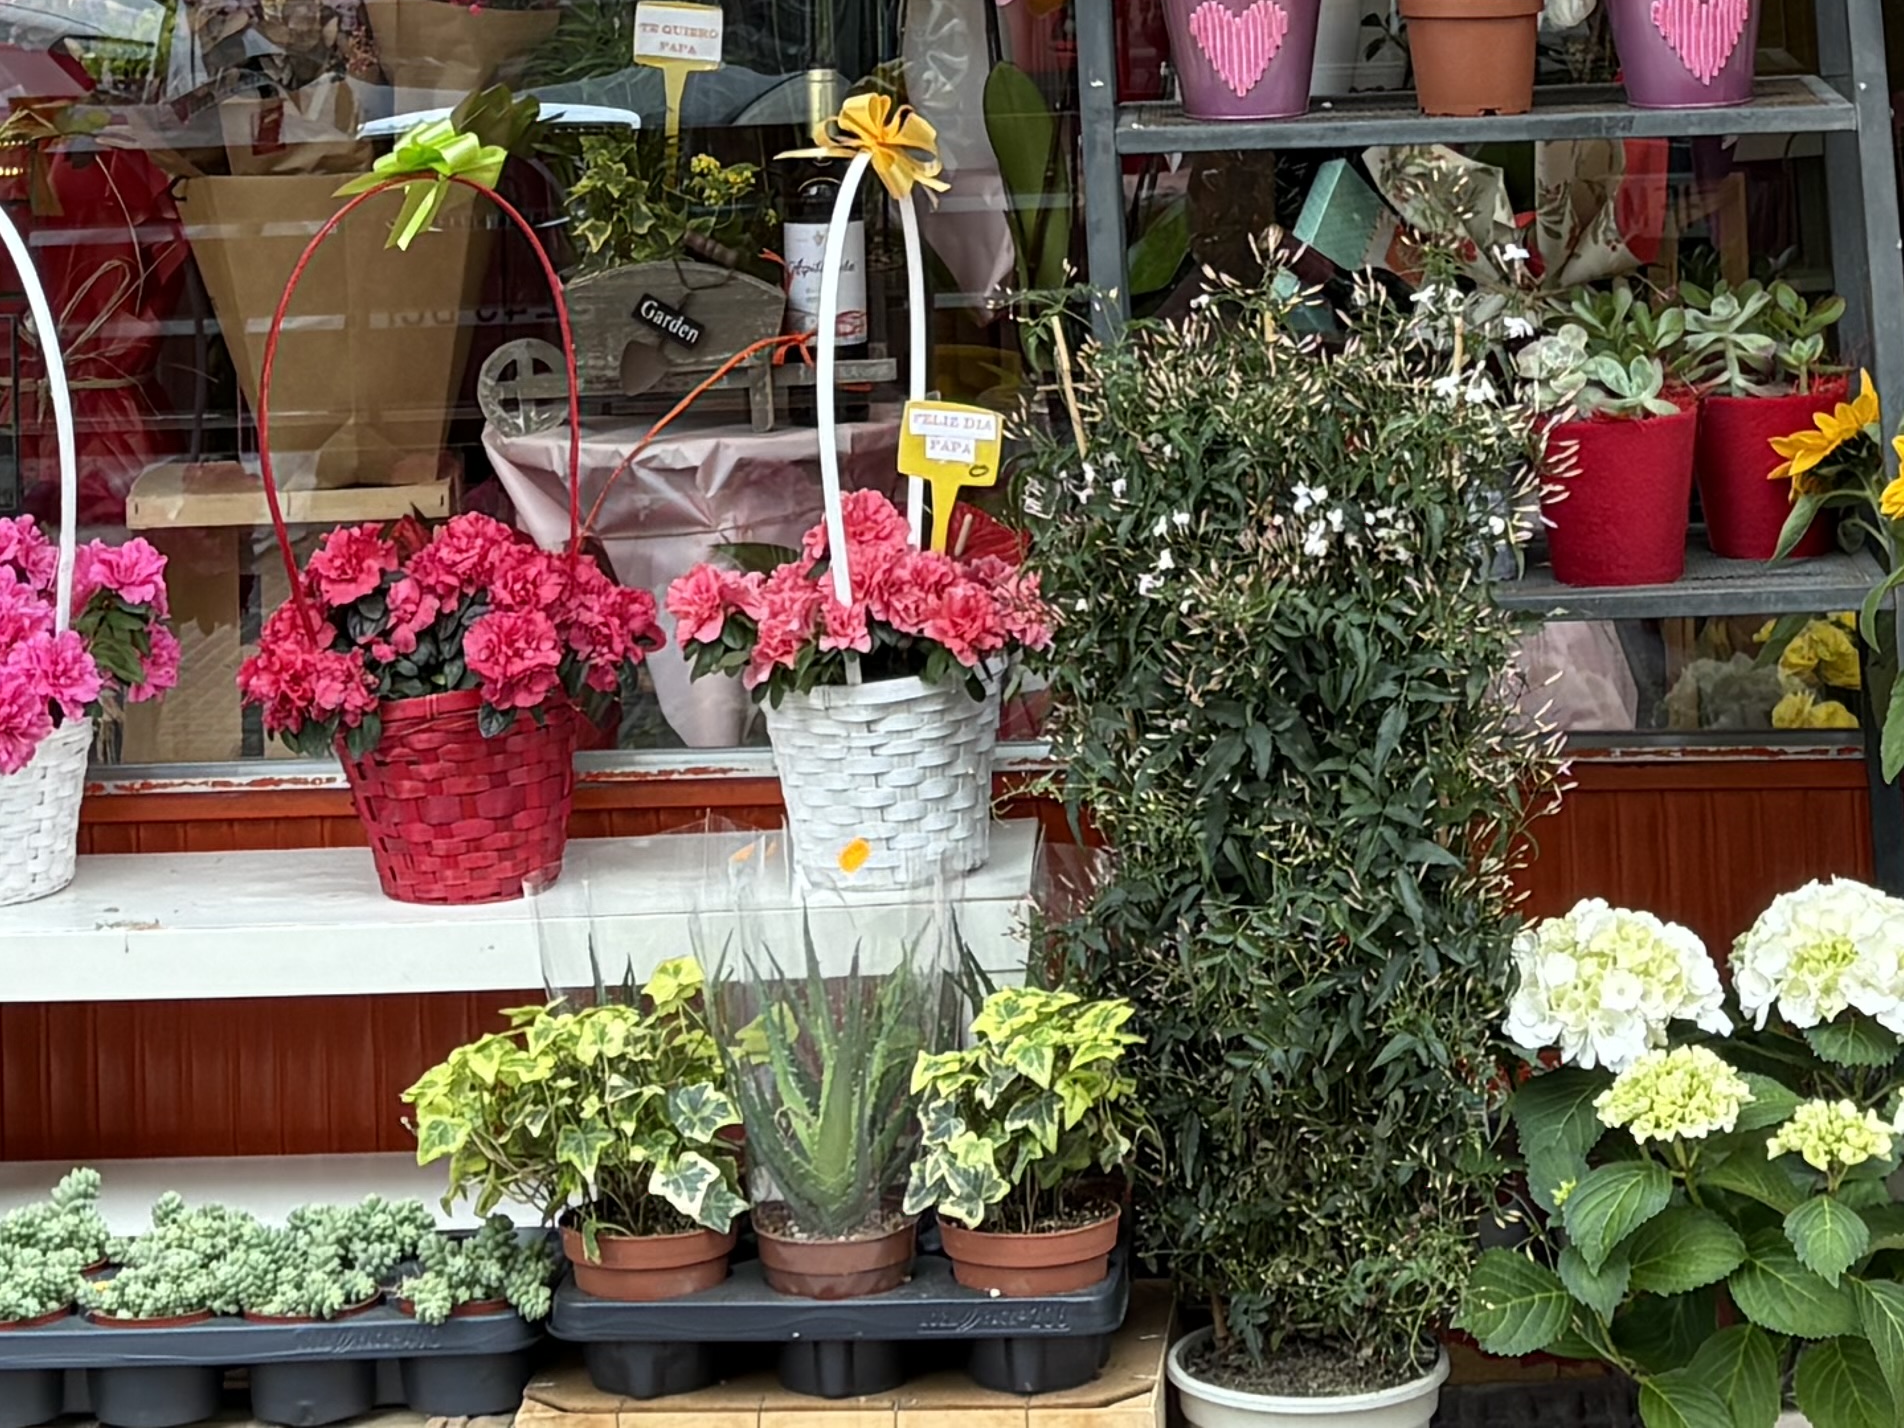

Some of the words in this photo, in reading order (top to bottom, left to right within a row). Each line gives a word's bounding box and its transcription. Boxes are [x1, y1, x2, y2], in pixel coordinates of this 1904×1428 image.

[639, 20, 657, 36] TE
[659, 22, 720, 40] QUIERO
[637, 298, 701, 344] Garden
[911, 413, 959, 430] FELIZ
[962, 416, 995, 433] DIA
[929, 439, 973, 457] PAPA
